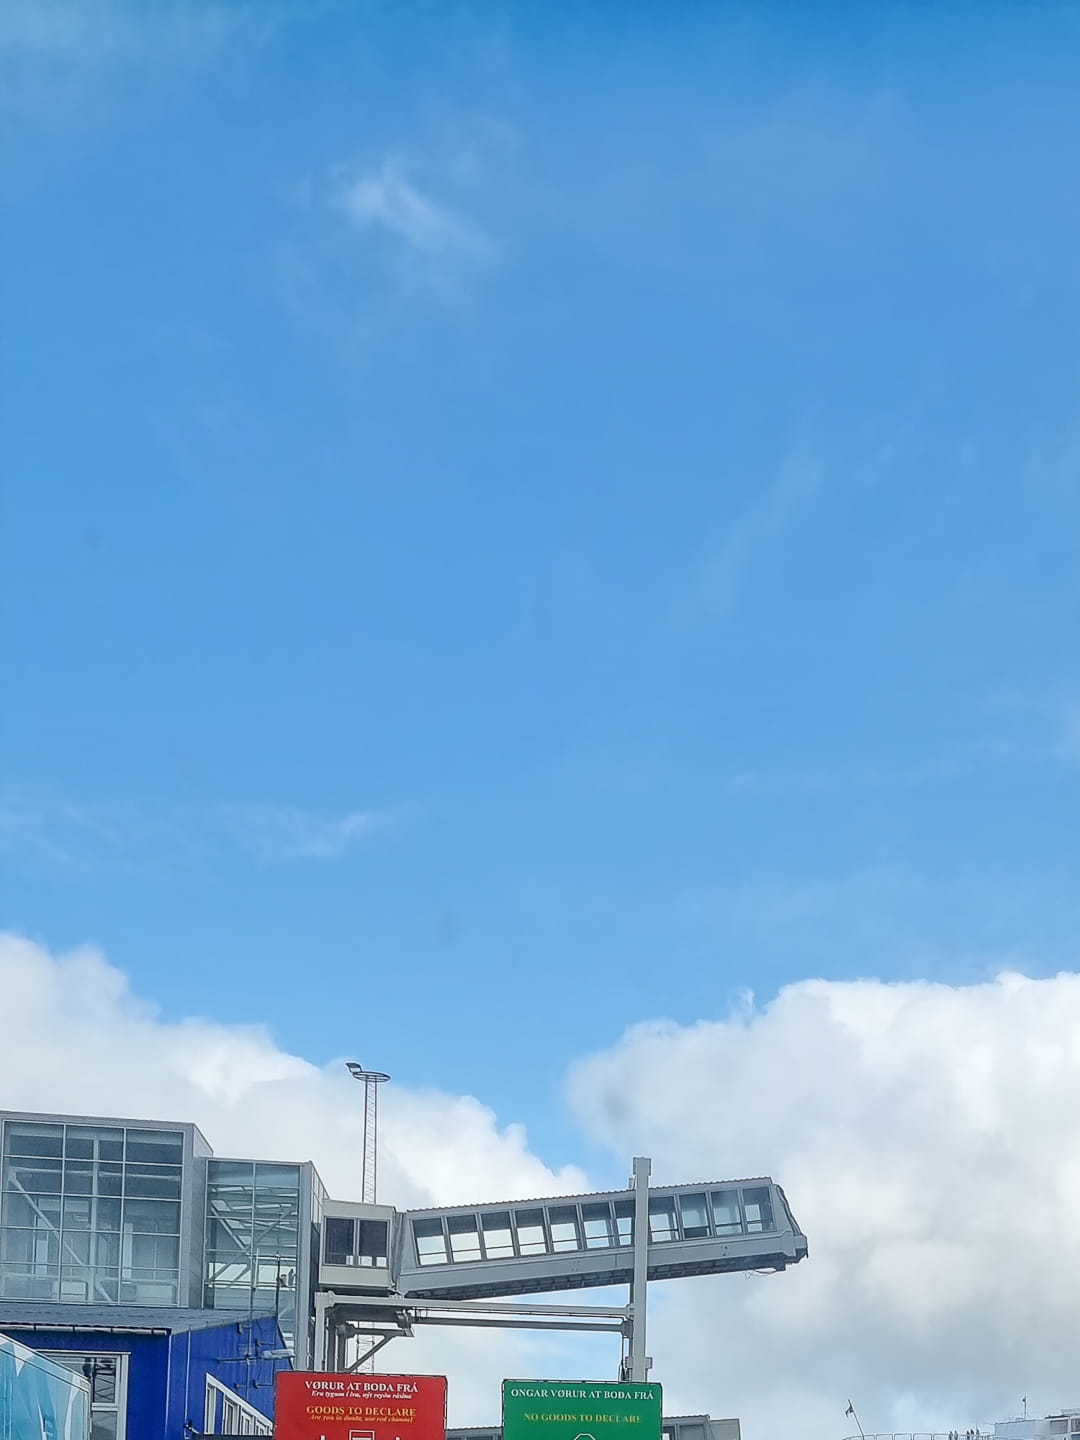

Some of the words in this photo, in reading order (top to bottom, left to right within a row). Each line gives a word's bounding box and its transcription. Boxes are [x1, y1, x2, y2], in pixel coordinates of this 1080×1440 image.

[305, 1381, 344, 1390] VØRUR
[347, 1382, 360, 1391] AT
[397, 1382, 418, 1392] FRÁ
[511, 1388, 548, 1398] ONGAR
[551, 1389, 587, 1398] VØRUR
[589, 1390, 602, 1398] AT
[634, 1389, 654, 1400] FRÁ
[306, 1405, 345, 1415] GOODS
[349, 1406, 362, 1415] TO
[365, 1407, 416, 1417] DECLARE
[524, 1413, 538, 1421] NO
[541, 1413, 577, 1422] GOODS
[580, 1414, 593, 1422] TO
[595, 1414, 640, 1423] DECLARE
